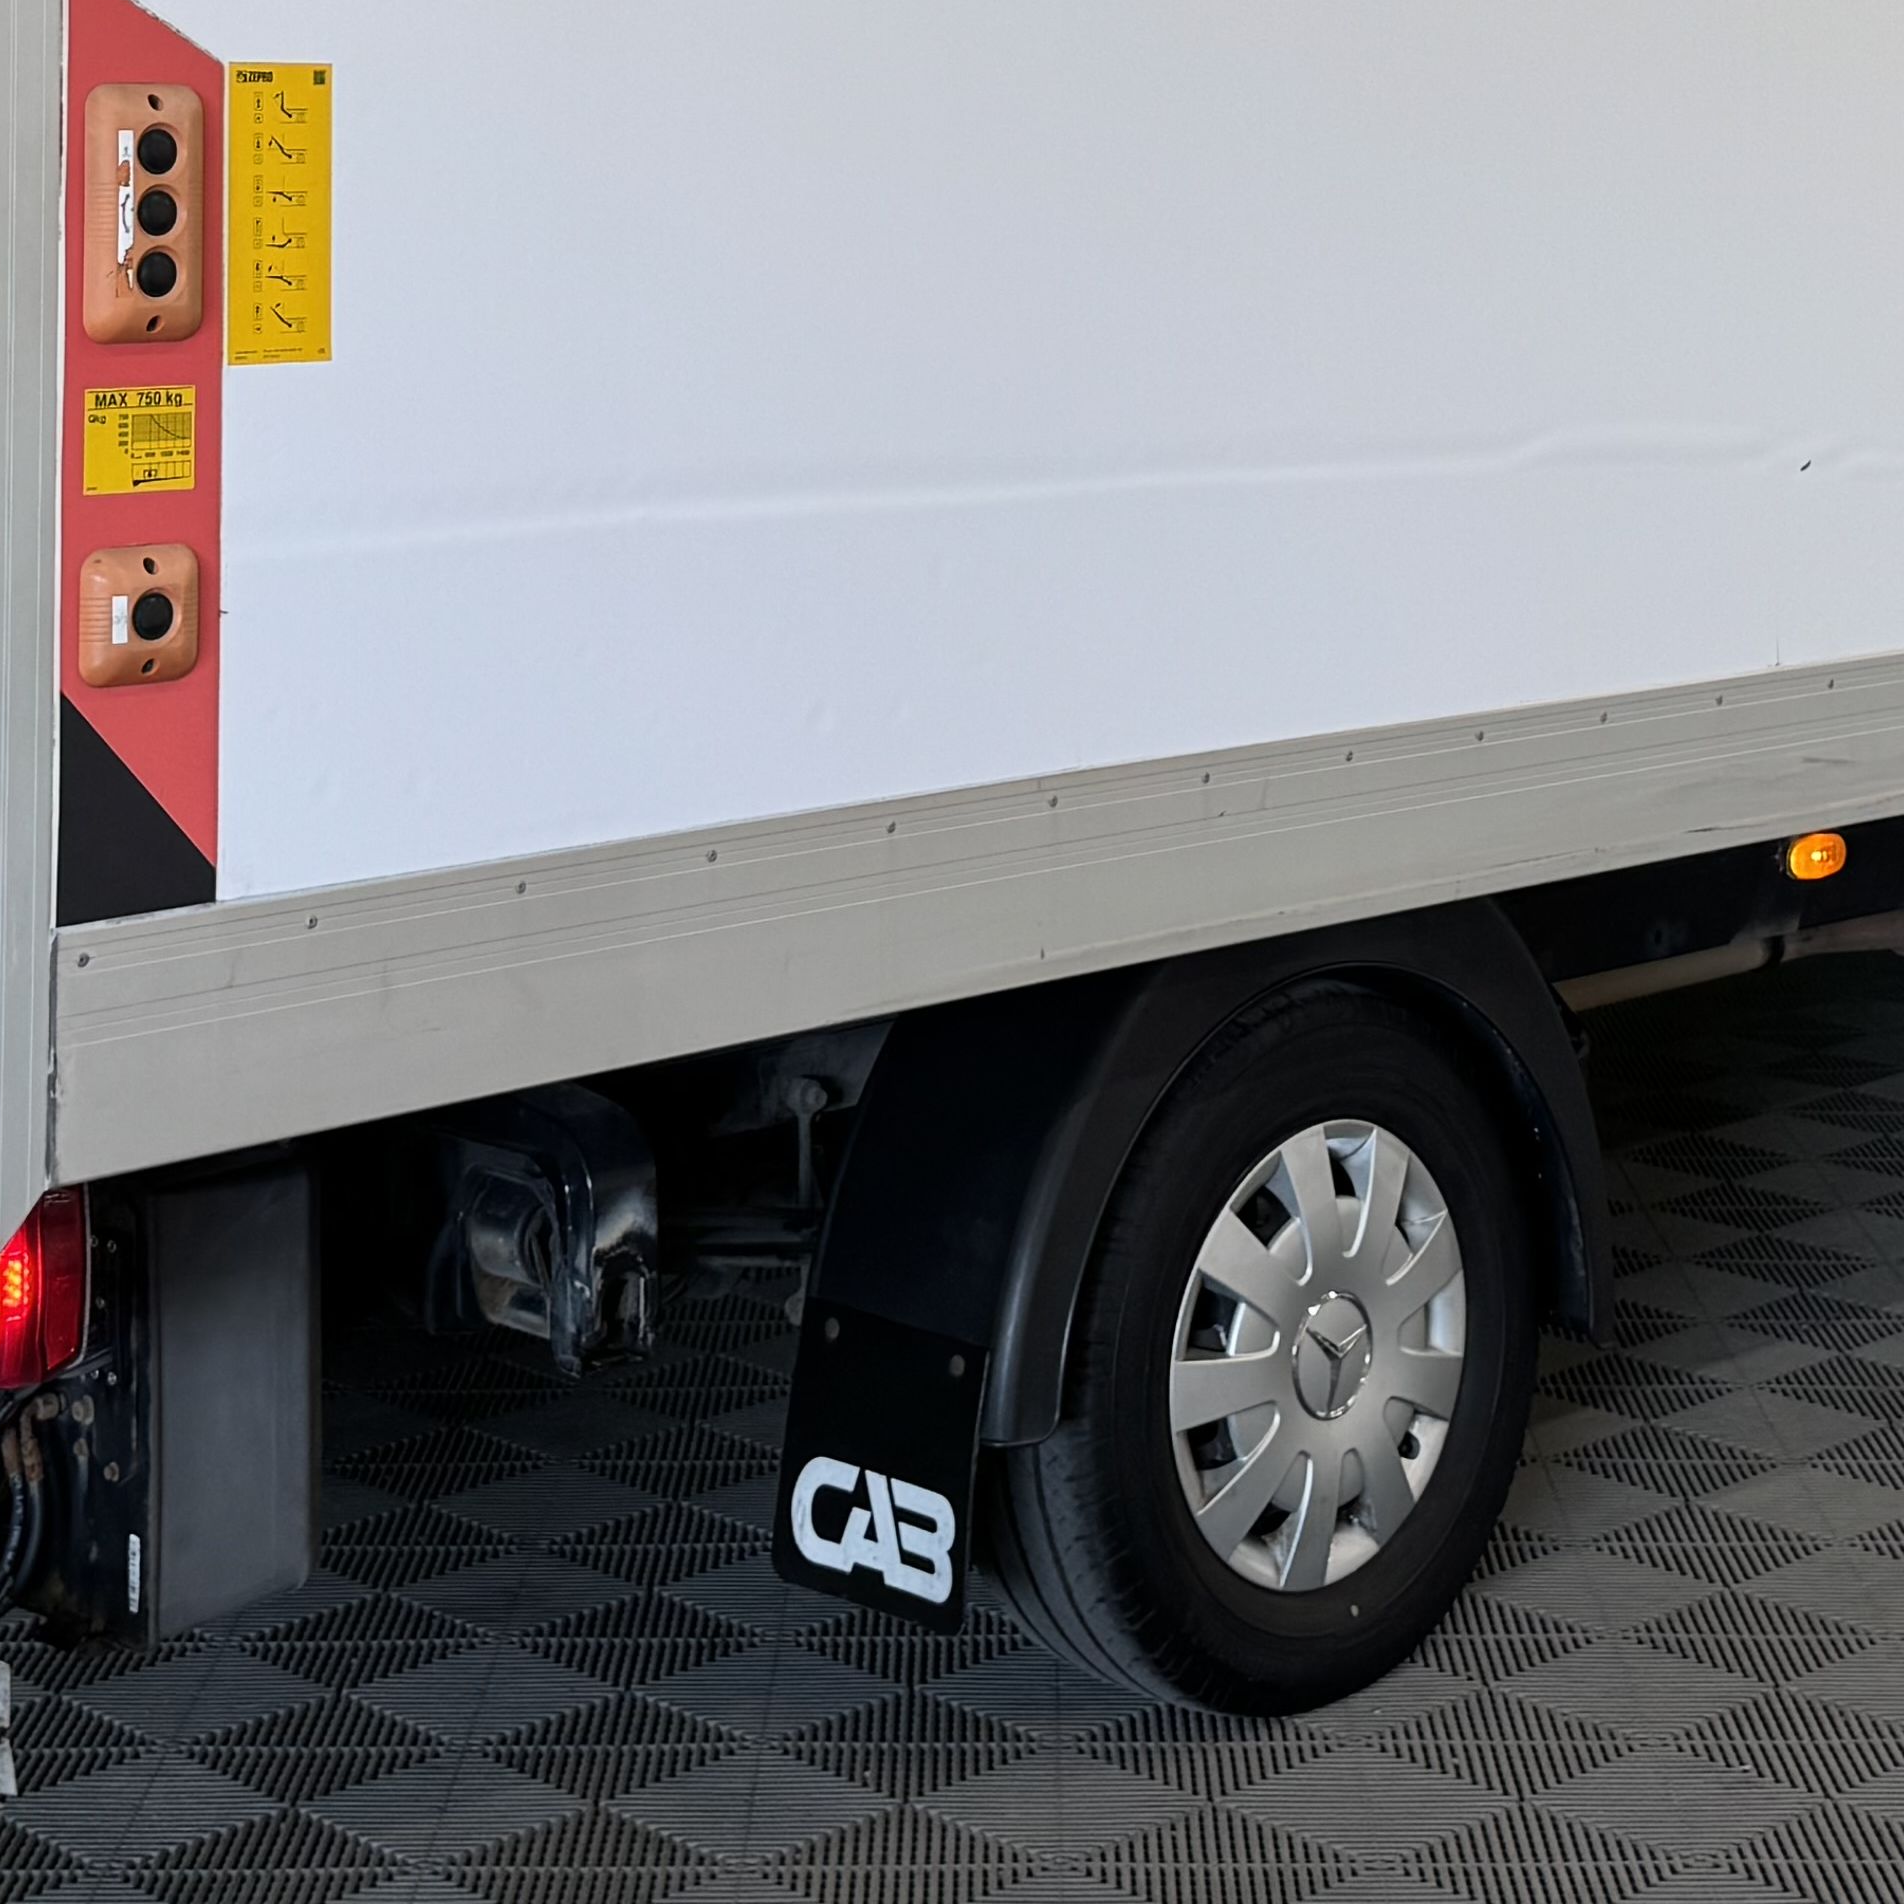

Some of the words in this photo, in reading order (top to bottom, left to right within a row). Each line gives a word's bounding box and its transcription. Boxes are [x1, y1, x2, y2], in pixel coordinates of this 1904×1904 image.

[95, 393, 127, 408] MAX
[137, 391, 161, 407] 750
[165, 391, 183, 407] kg
[791, 1456, 956, 1604] CAB
